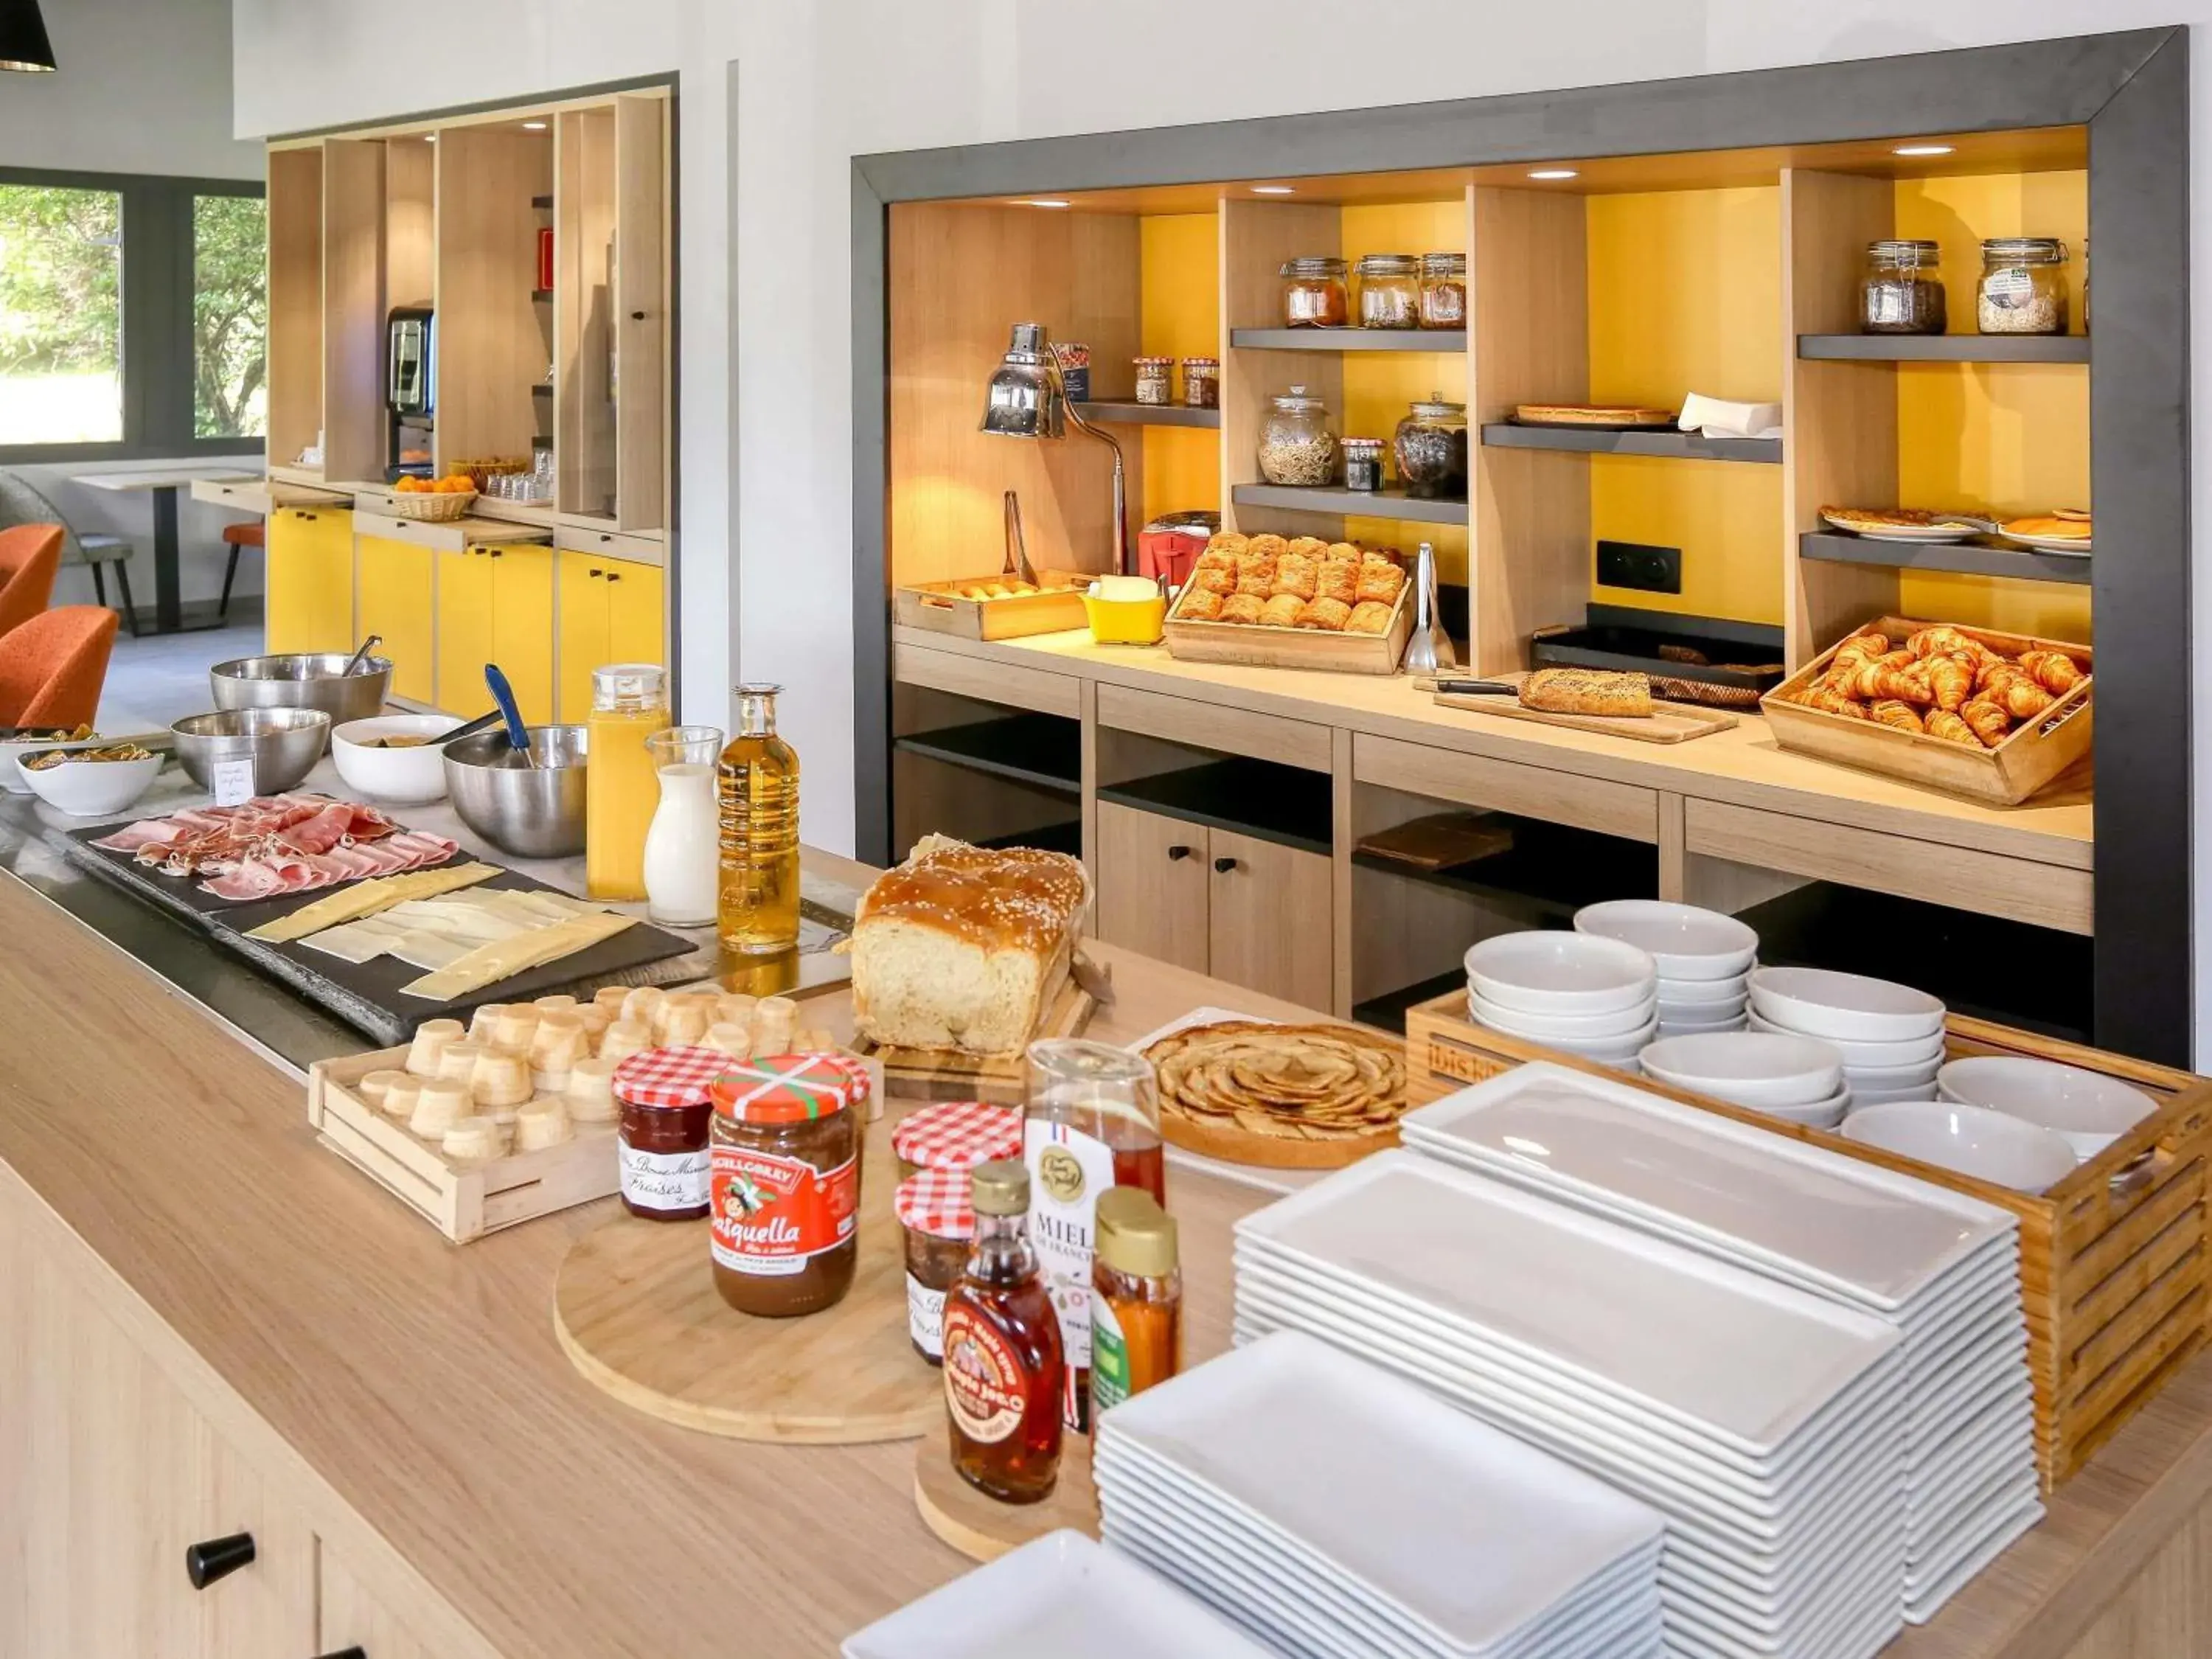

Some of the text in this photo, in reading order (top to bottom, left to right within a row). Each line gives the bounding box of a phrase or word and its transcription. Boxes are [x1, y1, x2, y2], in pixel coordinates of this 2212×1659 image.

[1427, 1043, 1467, 1075] ibis
[712, 1217, 800, 1248] asquella
[1036, 1211, 1093, 1248] MIEL
